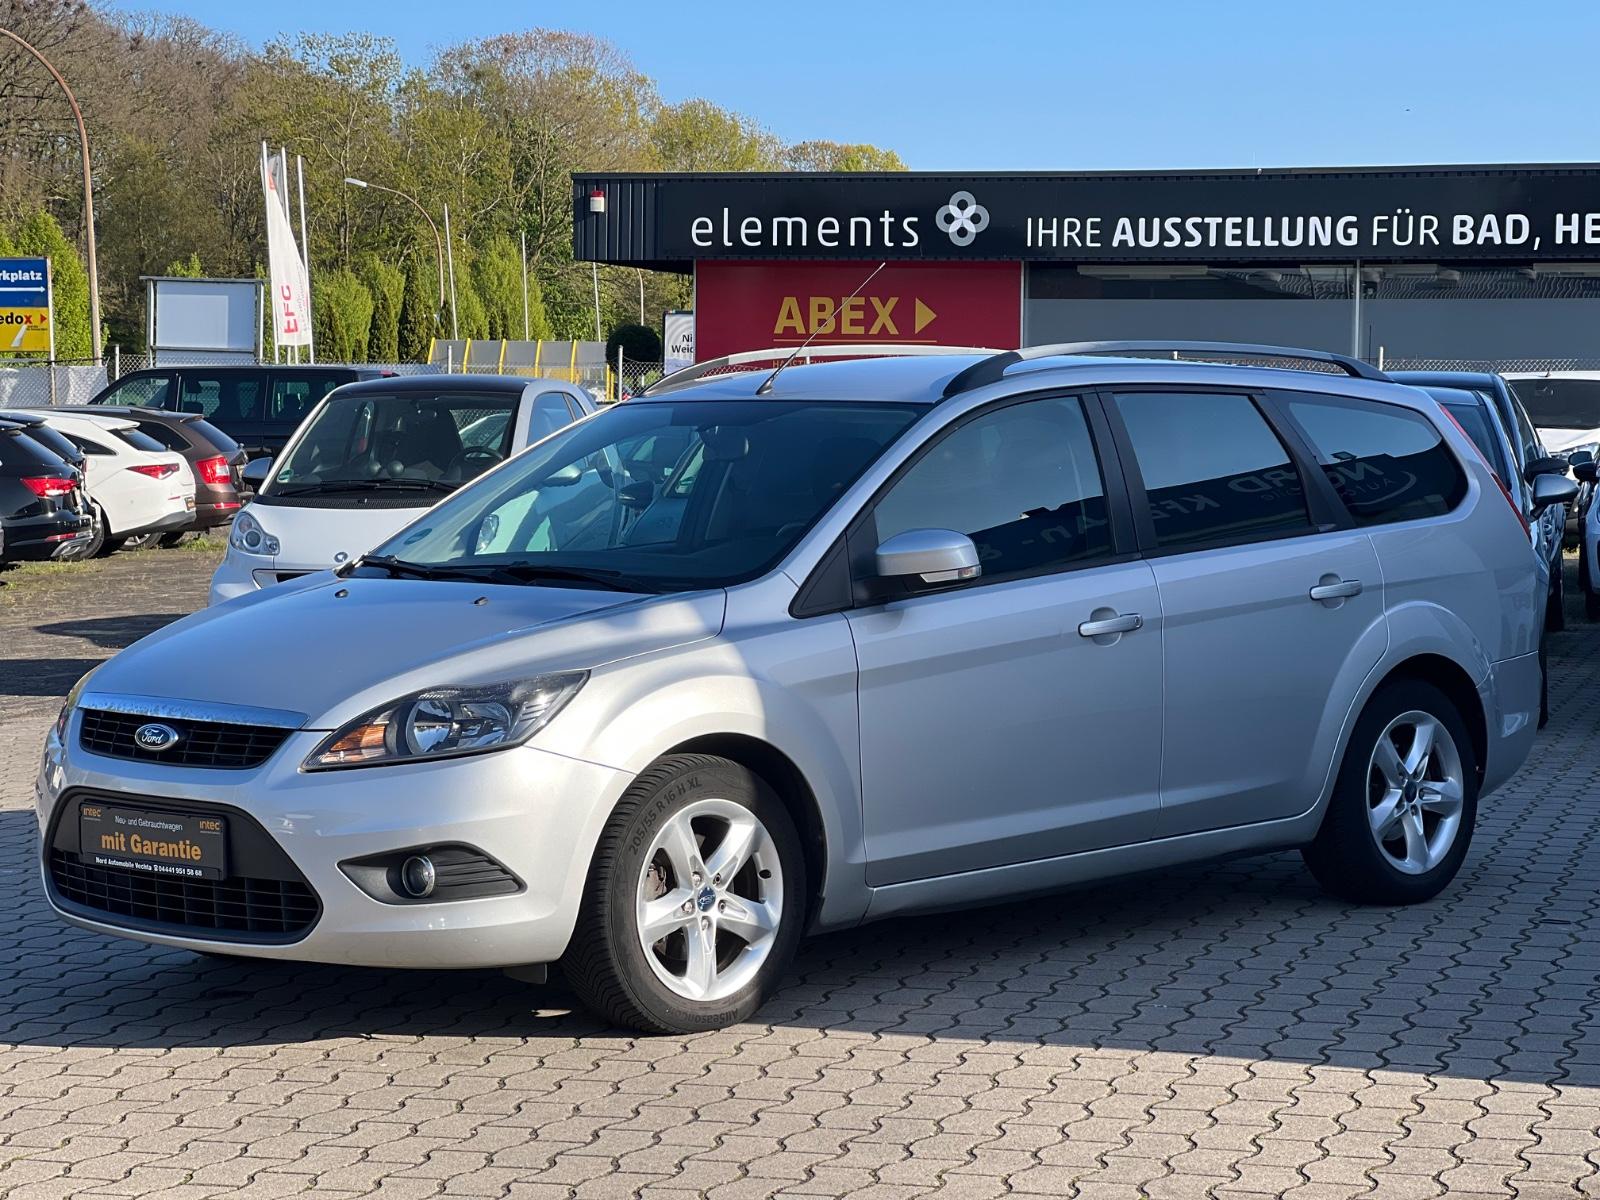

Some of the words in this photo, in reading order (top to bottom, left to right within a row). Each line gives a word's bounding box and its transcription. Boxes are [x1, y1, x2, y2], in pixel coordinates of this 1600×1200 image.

[691, 207, 919, 247] elements
[1026, 217, 1102, 248] IHRE
[1111, 215, 1358, 248] AUSSTELLUNG
[1371, 208, 1440, 246] FÜR
[1452, 213, 1541, 251] BAD,
[772, 296, 900, 335] ABEX
[141, 728, 165, 744] Ford
[127, 817, 138, 826] und
[138, 818, 183, 833] Gebrauchtwagen
[629, 810, 657, 855] 205/55
[656, 801, 666, 813] R
[664, 790, 676, 805] 16
[676, 785, 687, 796] H
[687, 776, 703, 790] XL
[101, 831, 126, 852] mit
[130, 833, 202, 861] Garantie
[95, 856, 107, 865] Nord
[107, 857, 134, 869] Automobile
[134, 861, 152, 872] Vechta
